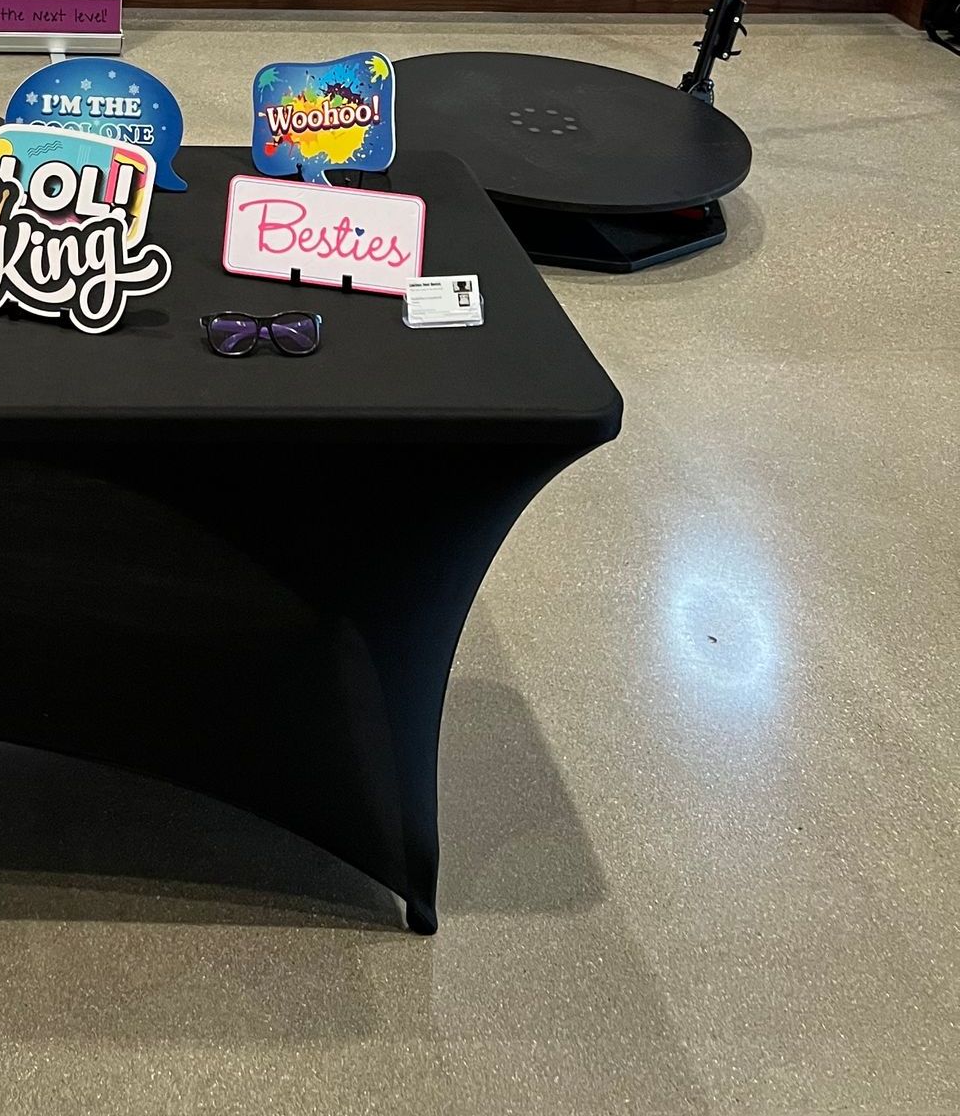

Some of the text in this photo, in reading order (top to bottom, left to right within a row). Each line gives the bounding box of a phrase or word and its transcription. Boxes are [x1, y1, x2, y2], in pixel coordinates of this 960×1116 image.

[0, 8, 25, 21] the
[41, 94, 142, 118] I'M THE
[266, 95, 380, 134] Woohoo!
[99, 124, 155, 144] ONE
[239, 198, 411, 268] Besties
